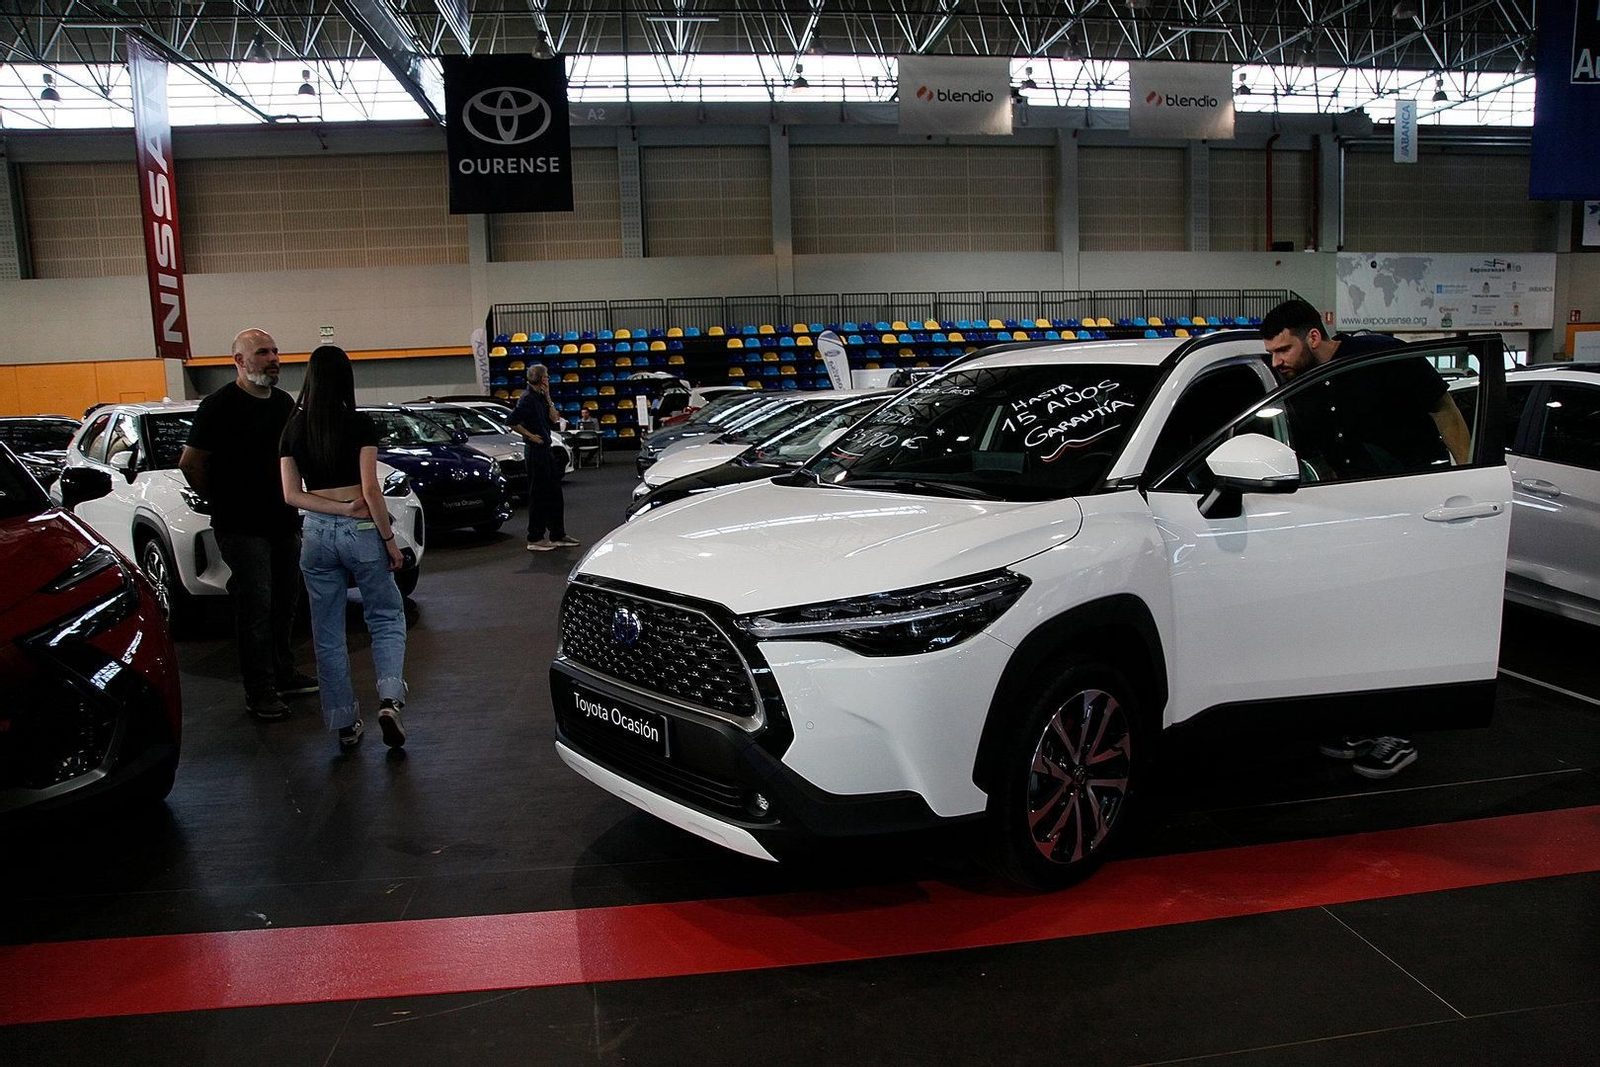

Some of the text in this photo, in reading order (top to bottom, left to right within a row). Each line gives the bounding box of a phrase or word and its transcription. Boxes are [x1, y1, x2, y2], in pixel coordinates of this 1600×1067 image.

[937, 89, 994, 103] blendio
[1165, 94, 1218, 107] blendio
[587, 108, 606, 120] A2
[459, 157, 560, 175] OURENSE
[1341, 316, 1427, 327] www.expourense.org
[1011, 383, 1073, 411] HASTA
[1002, 411, 1037, 432] 15
[1024, 399, 1135, 447] GARANTÍA
[573, 691, 659, 743] Toyota Ocasión
